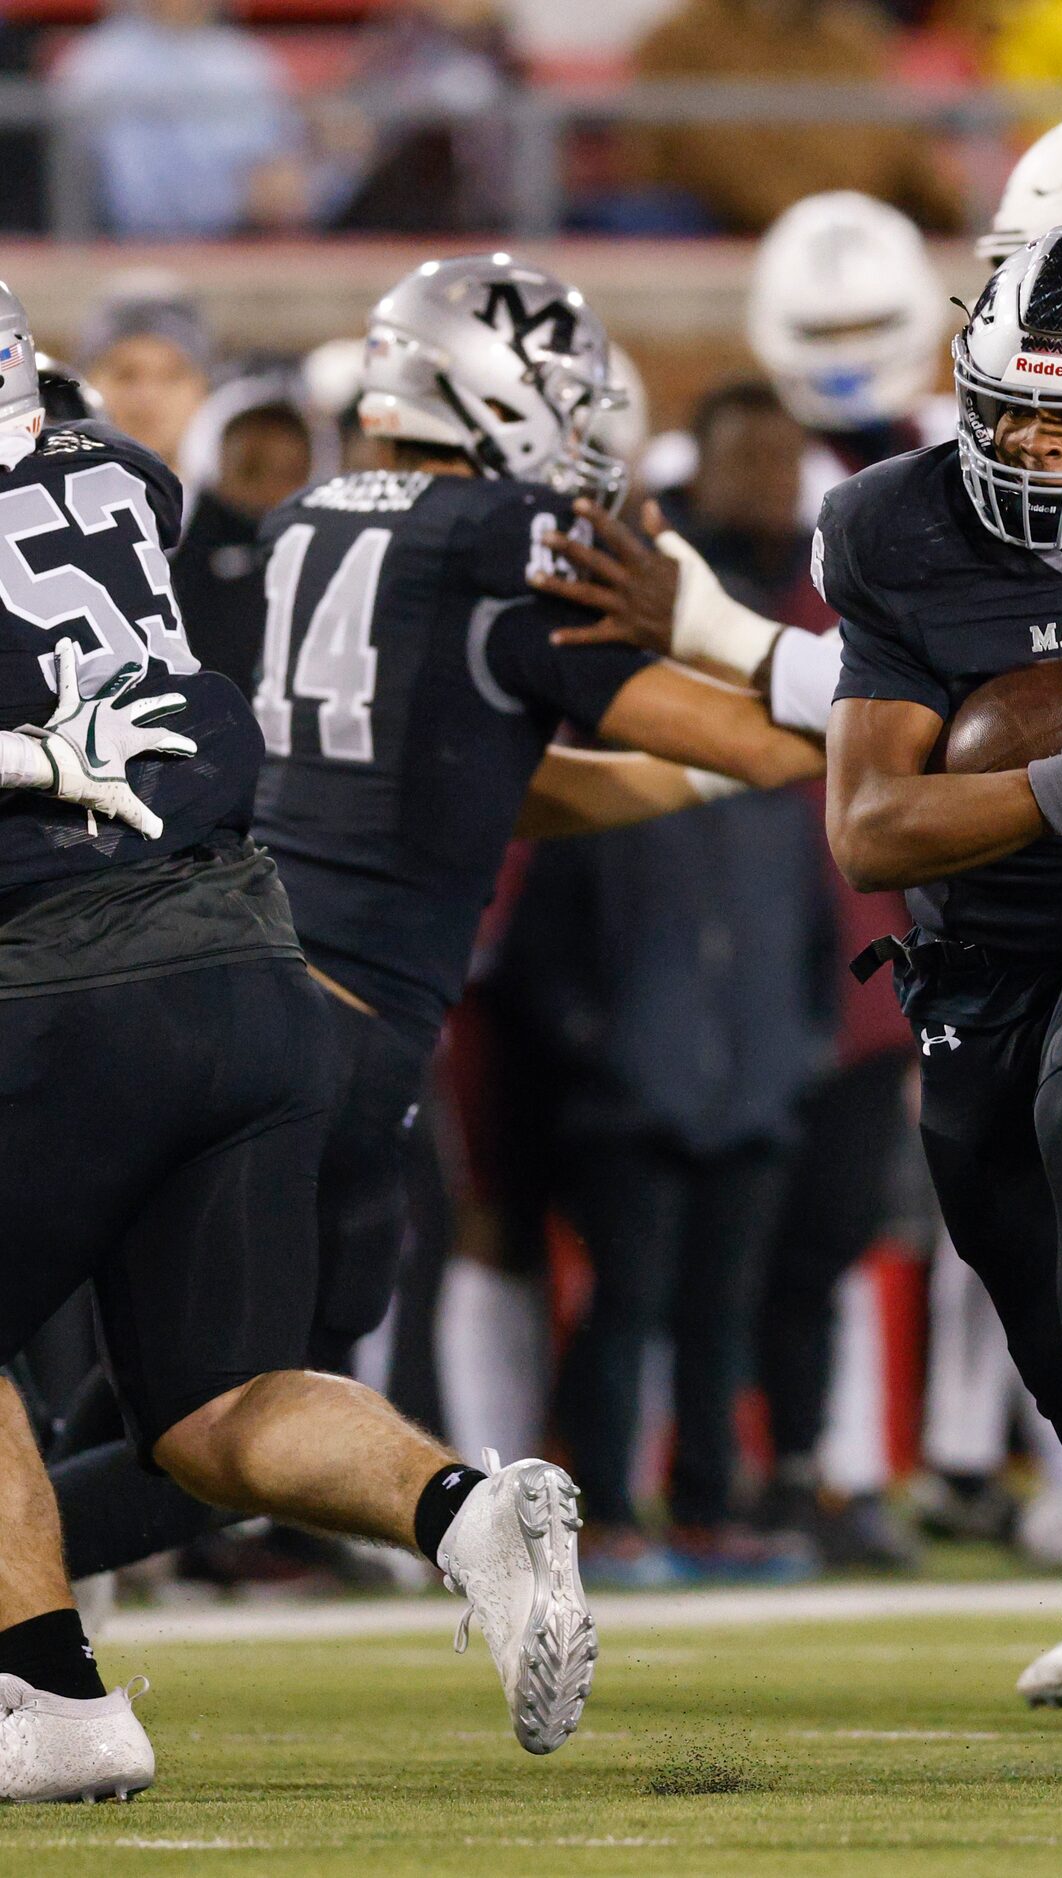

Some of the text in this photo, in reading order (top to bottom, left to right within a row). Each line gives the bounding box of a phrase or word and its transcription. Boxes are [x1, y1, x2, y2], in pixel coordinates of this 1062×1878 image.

[474, 282, 578, 356] M
[0, 462, 201, 697] 53
[254, 522, 393, 763] 14
